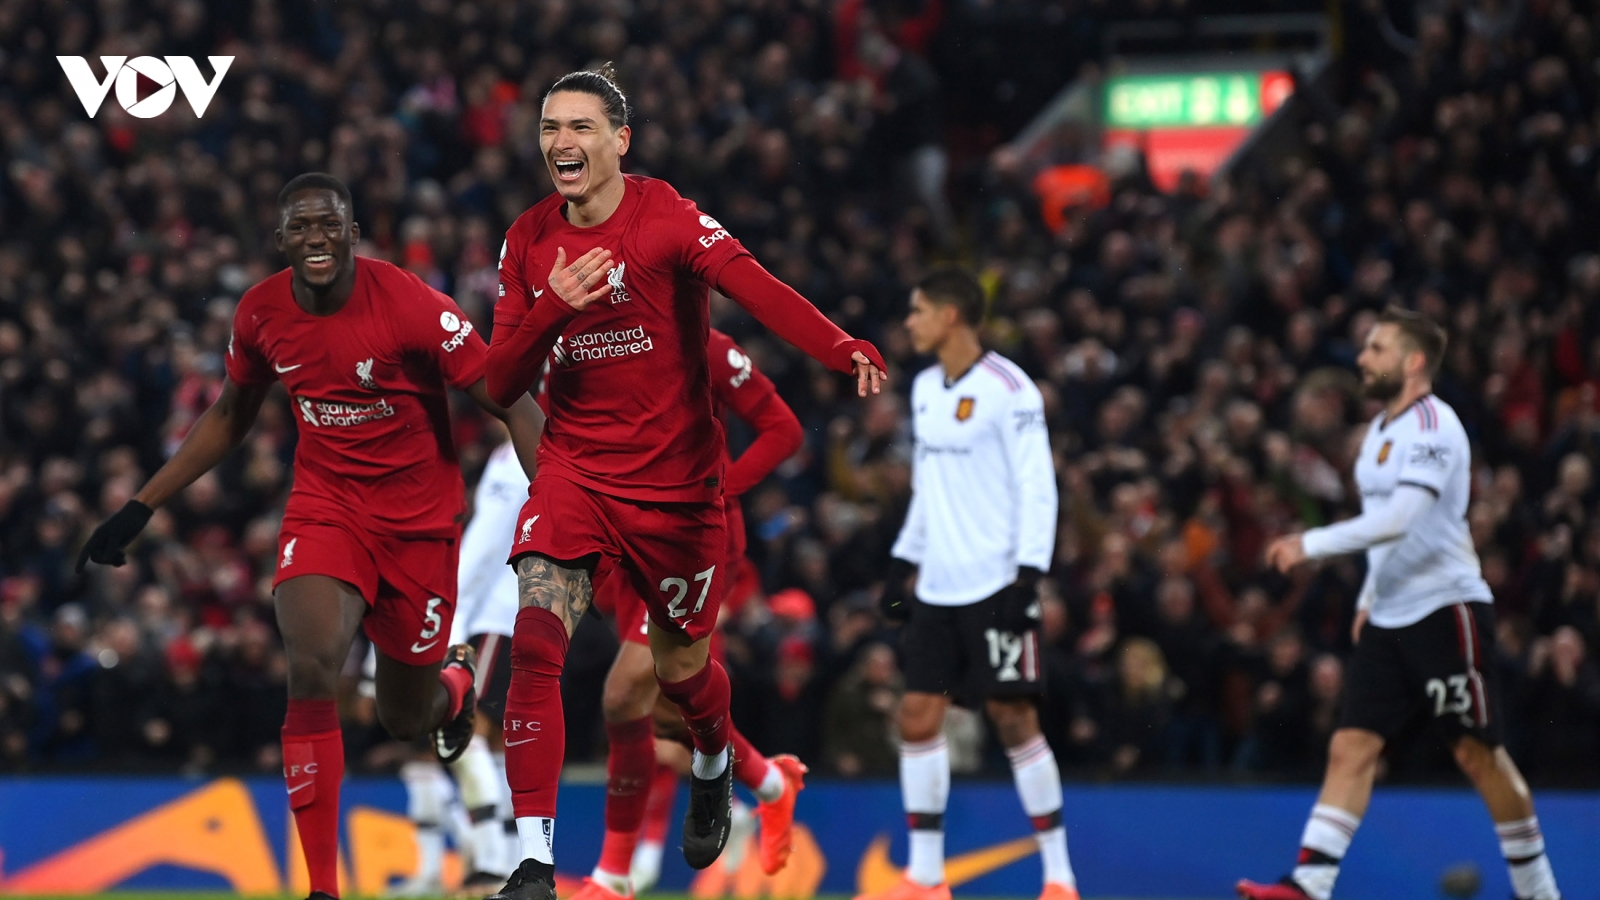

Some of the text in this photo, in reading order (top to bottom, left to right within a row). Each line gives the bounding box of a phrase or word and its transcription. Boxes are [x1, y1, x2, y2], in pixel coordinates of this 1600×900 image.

[568, 324, 645, 348] standard
[571, 336, 654, 361] chartered
[316, 398, 387, 414] standard
[320, 406, 395, 427] chartered
[659, 564, 716, 618] 27
[420, 597, 442, 640] 5
[984, 628, 1022, 668] 19
[1425, 674, 1472, 717] 23
